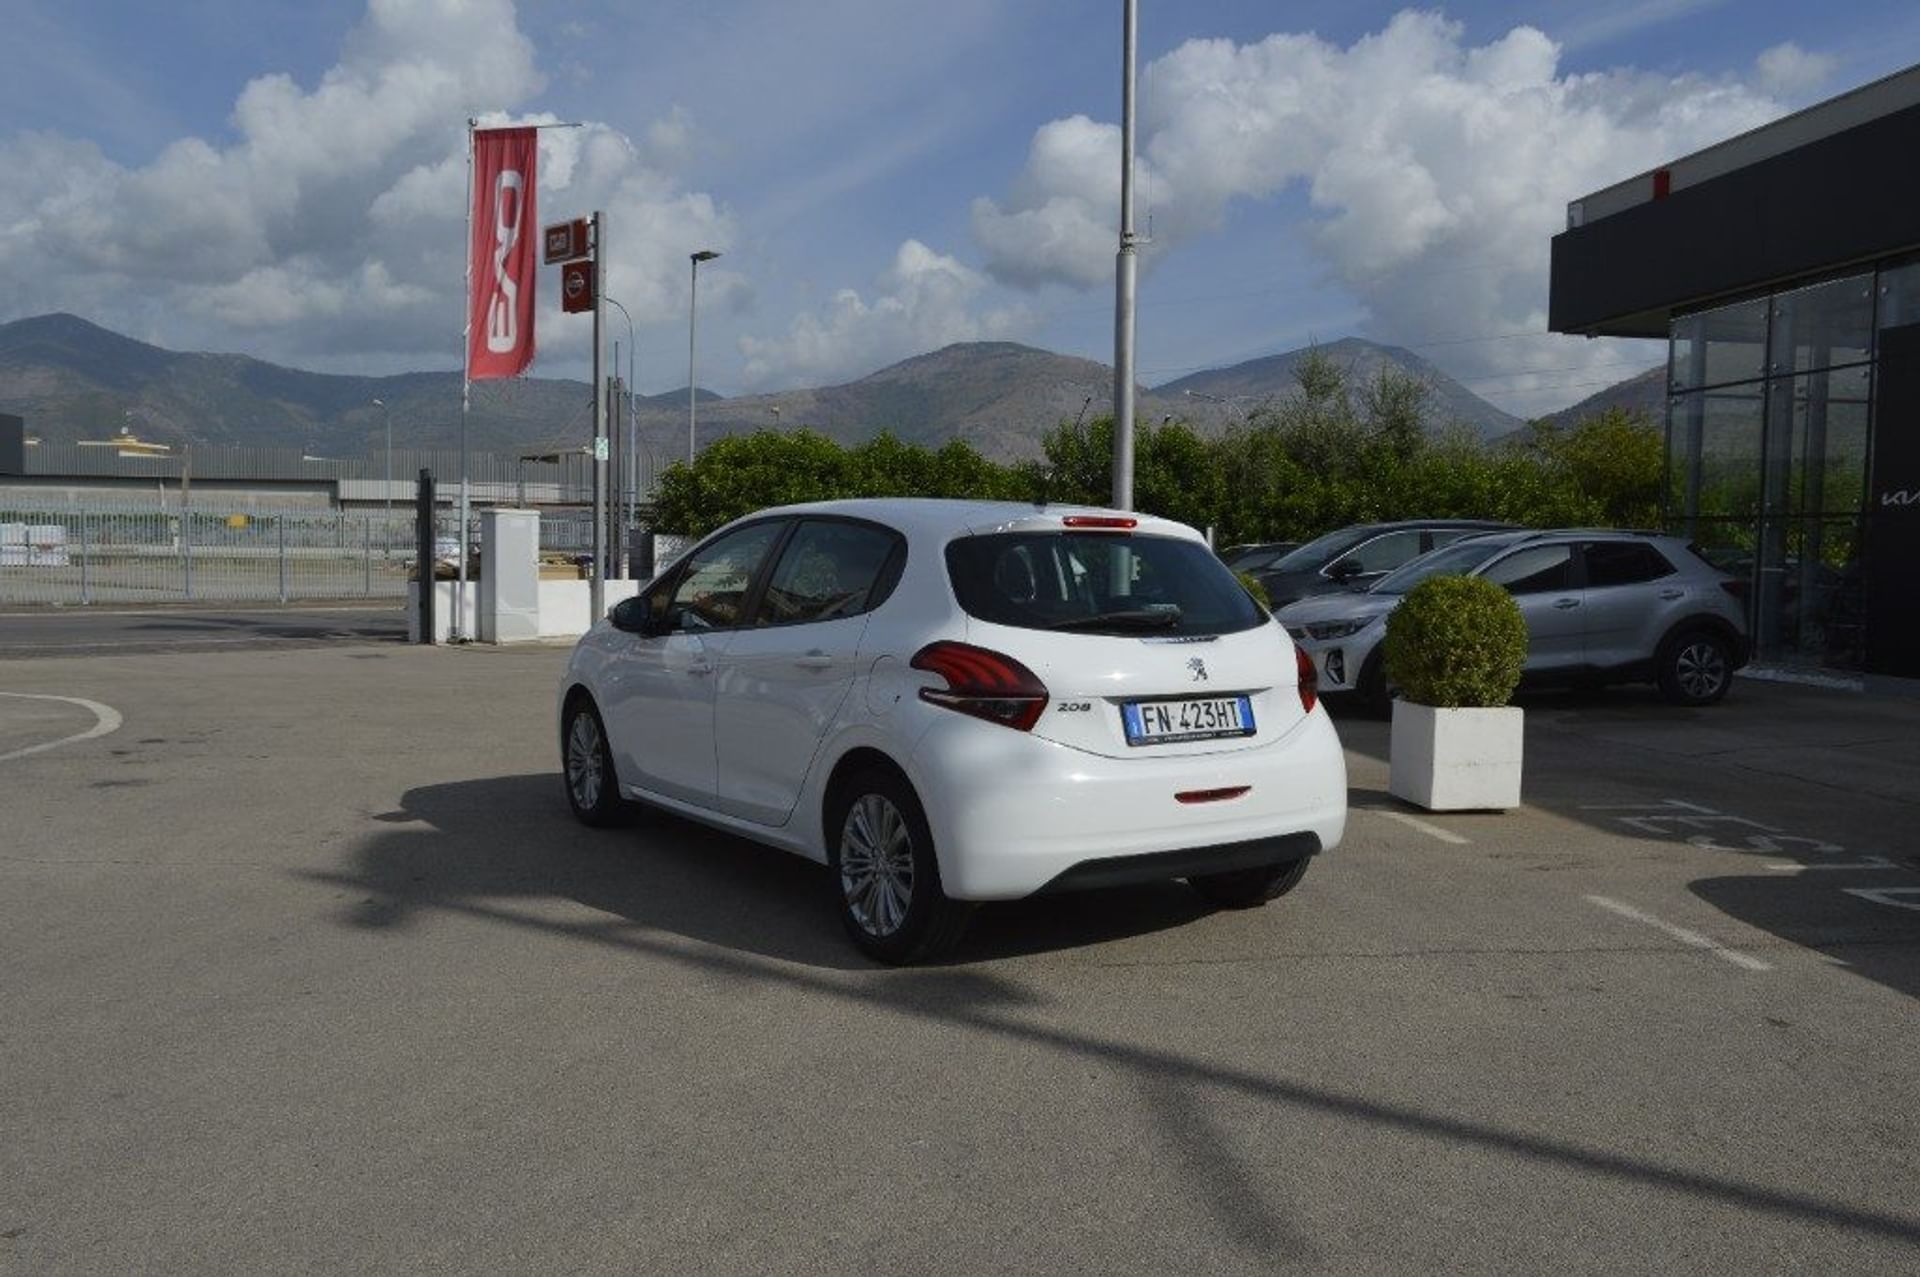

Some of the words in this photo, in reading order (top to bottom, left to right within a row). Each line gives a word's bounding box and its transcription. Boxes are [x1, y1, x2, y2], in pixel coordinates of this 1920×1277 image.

[1057, 702, 1092, 712] 208
[1141, 705, 1172, 734] FN
[1179, 700, 1240, 730] 423HT
